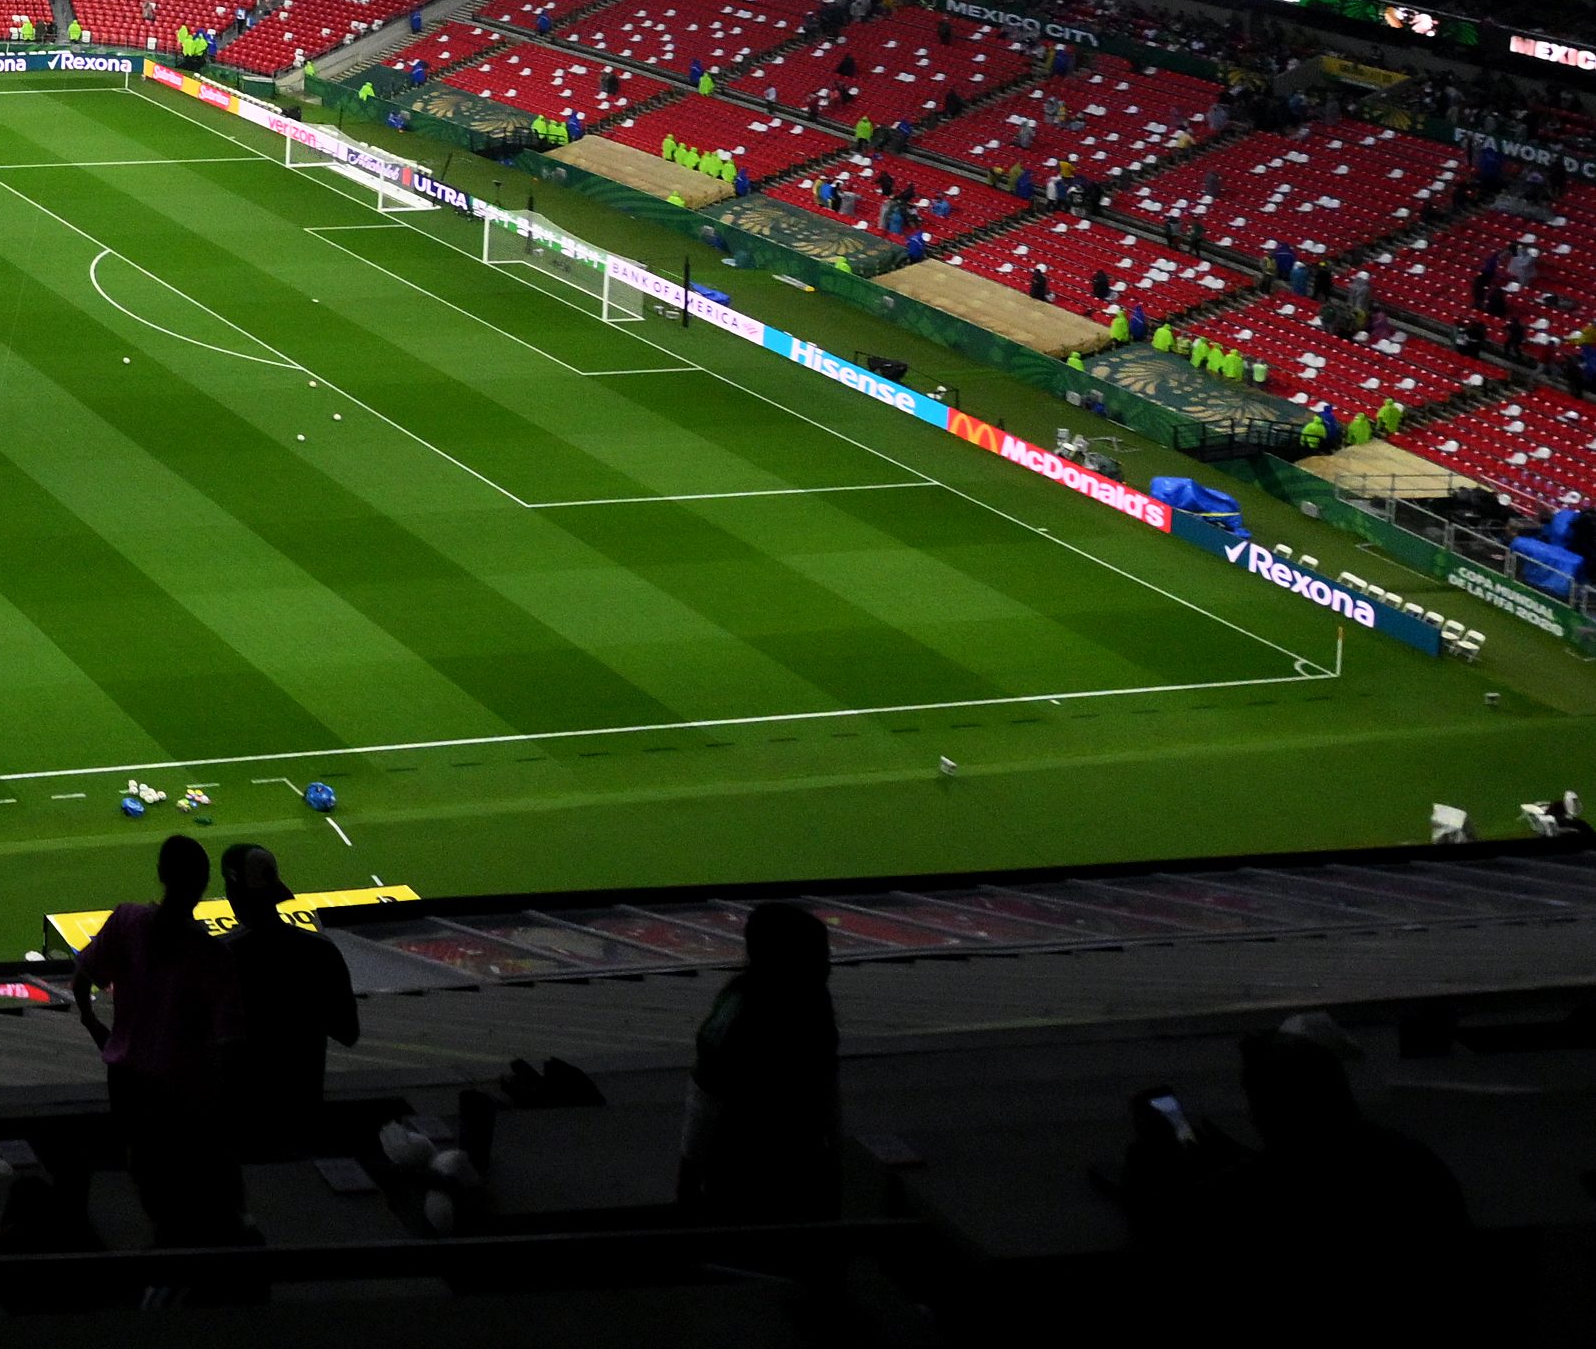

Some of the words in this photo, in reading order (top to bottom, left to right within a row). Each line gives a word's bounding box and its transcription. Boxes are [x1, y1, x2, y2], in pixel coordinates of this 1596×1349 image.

[946, 0, 1041, 34] MEXICO
[61, 53, 132, 72] Rexona
[269, 116, 316, 149] verizon
[1454, 128, 1498, 152] FFA
[1501, 139, 1578, 174] WORD
[348, 151, 400, 181] Michelob
[413, 174, 468, 210] ULTRA
[612, 263, 649, 288] BANK
[653, 281, 670, 302] OF
[673, 289, 740, 328] AMERICA
[791, 338, 915, 414] Hisense
[1001, 434, 1166, 528] McDonald's
[1248, 542, 1376, 628] Rexona
[1448, 574, 1466, 590] DE
